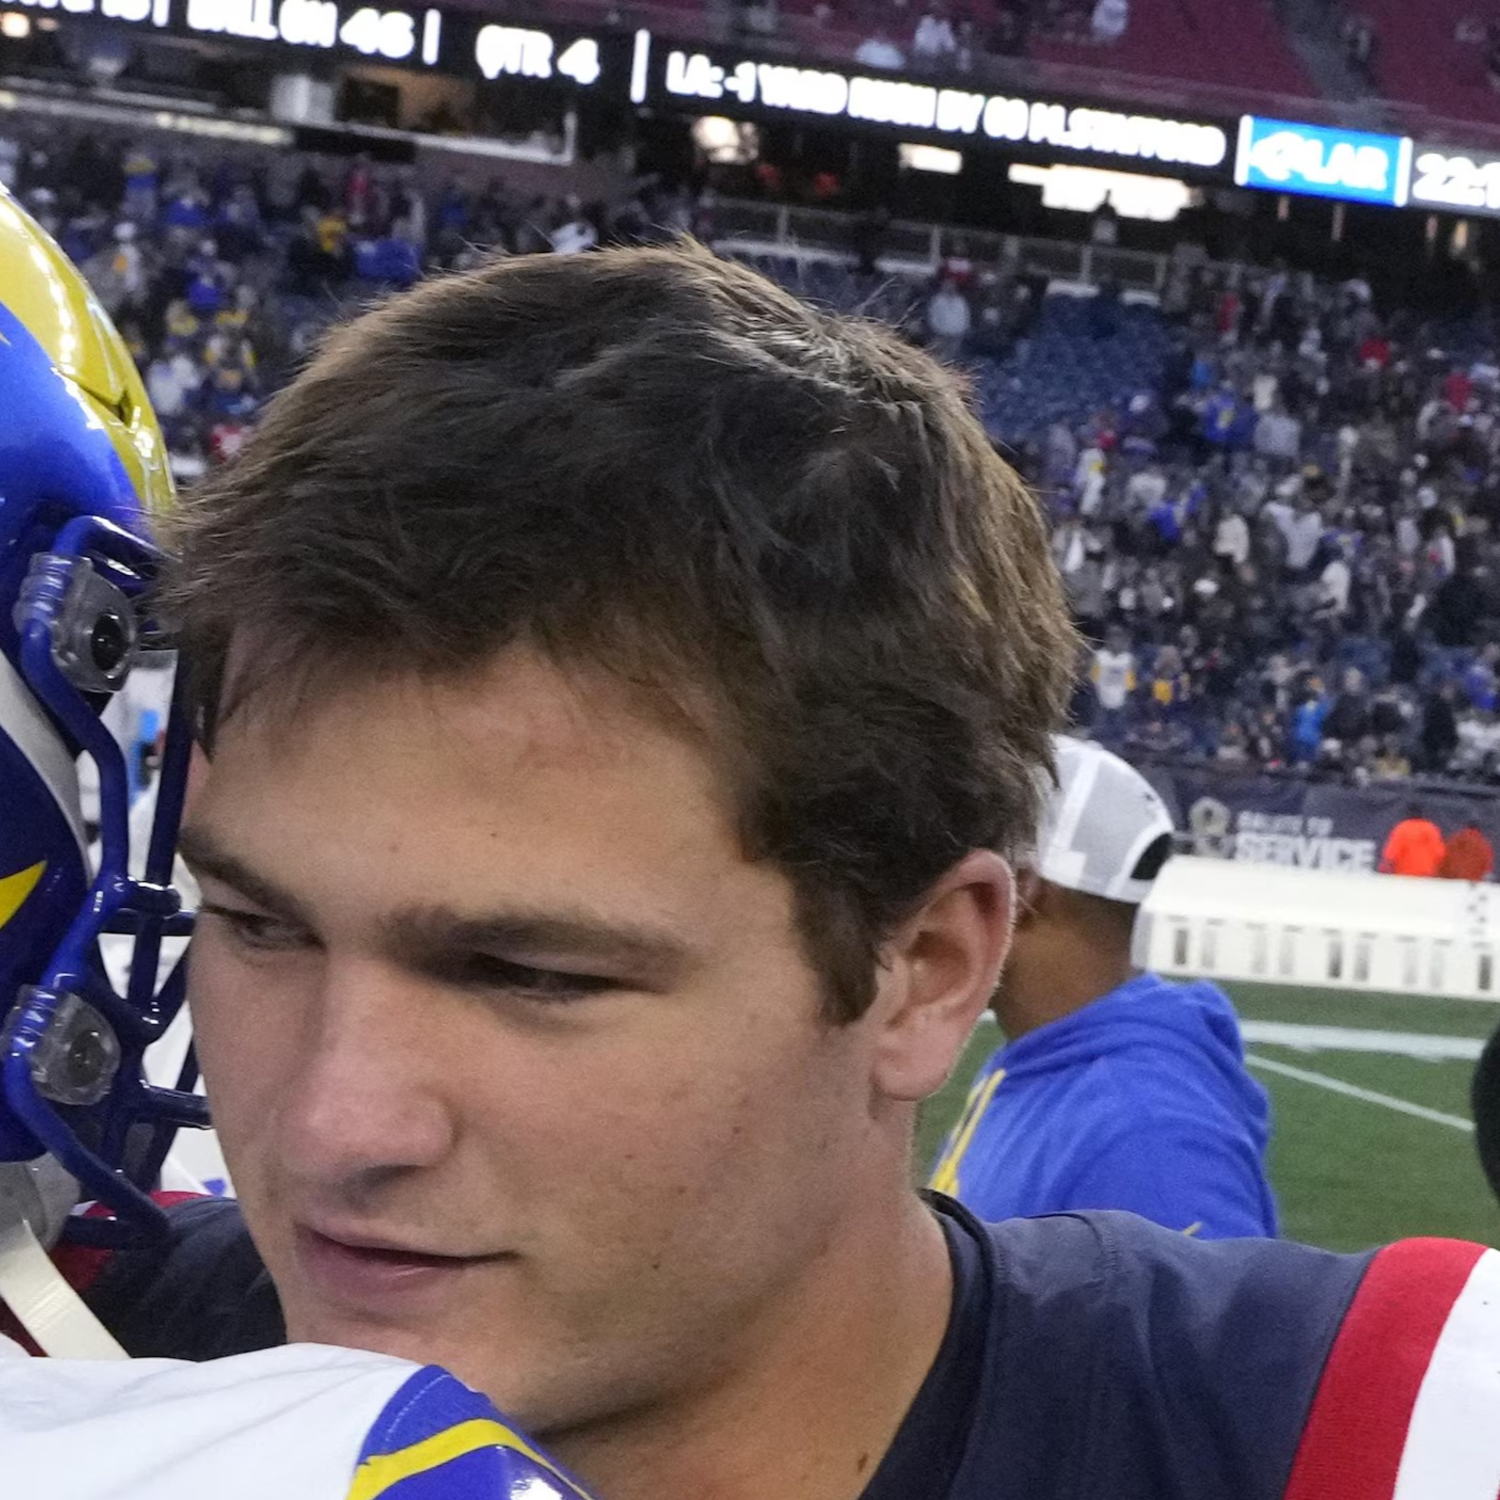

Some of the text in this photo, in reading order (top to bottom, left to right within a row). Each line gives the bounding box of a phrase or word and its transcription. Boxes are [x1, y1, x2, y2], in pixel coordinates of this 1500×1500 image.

[475, 24, 601, 84] QTR 4
[1234, 832, 1378, 873] SERVICE
